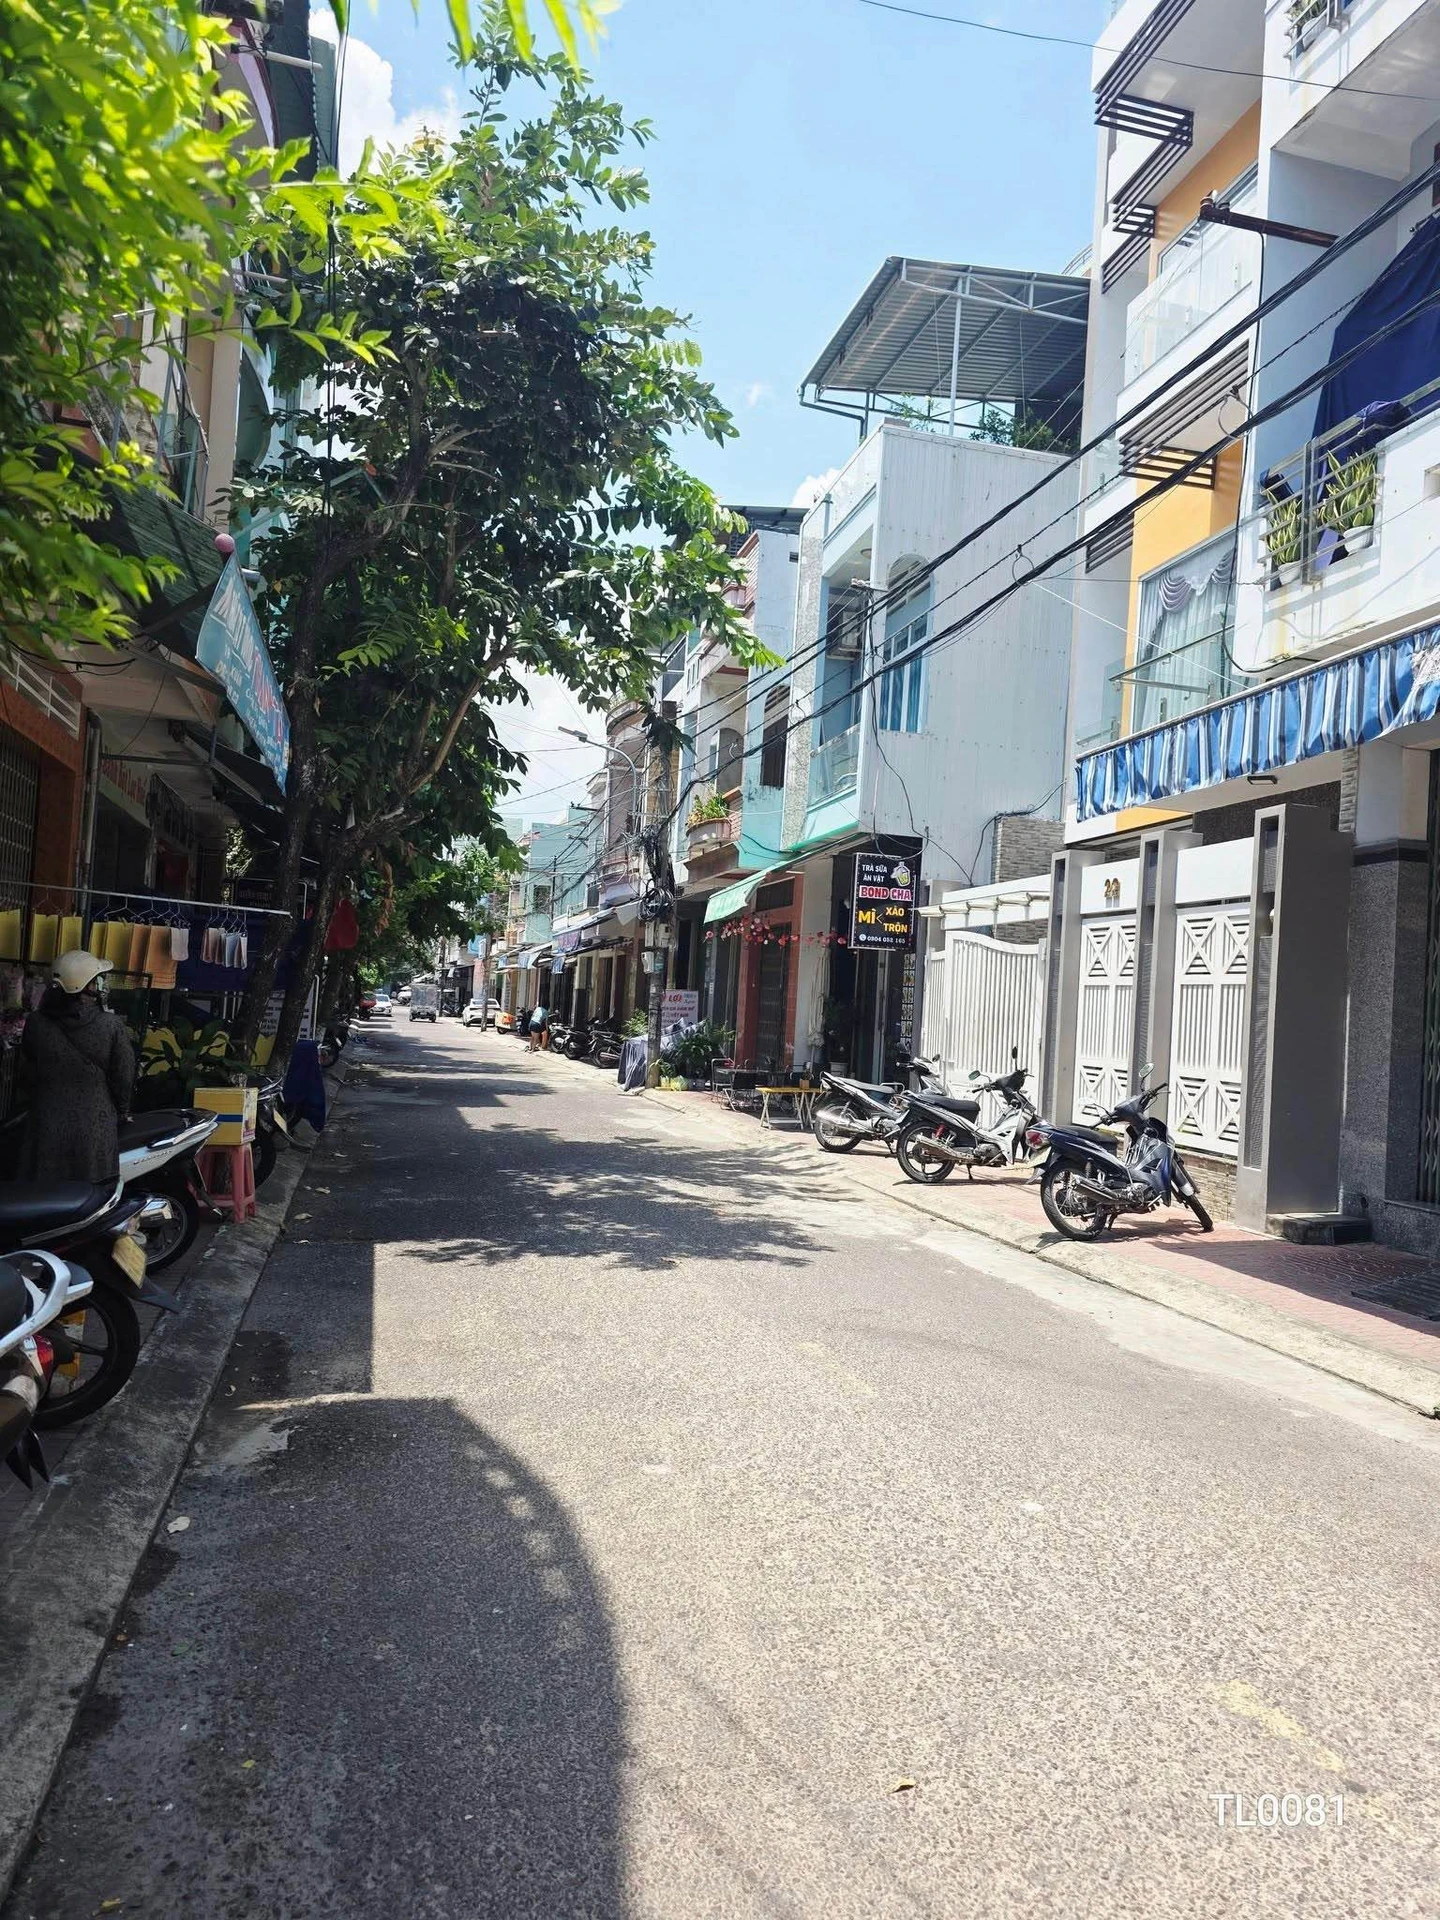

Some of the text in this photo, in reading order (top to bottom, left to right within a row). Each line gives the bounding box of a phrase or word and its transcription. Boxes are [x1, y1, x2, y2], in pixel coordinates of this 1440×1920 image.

[860, 885, 912, 901] BOND CHA
[858, 908, 876, 924] MÌ
